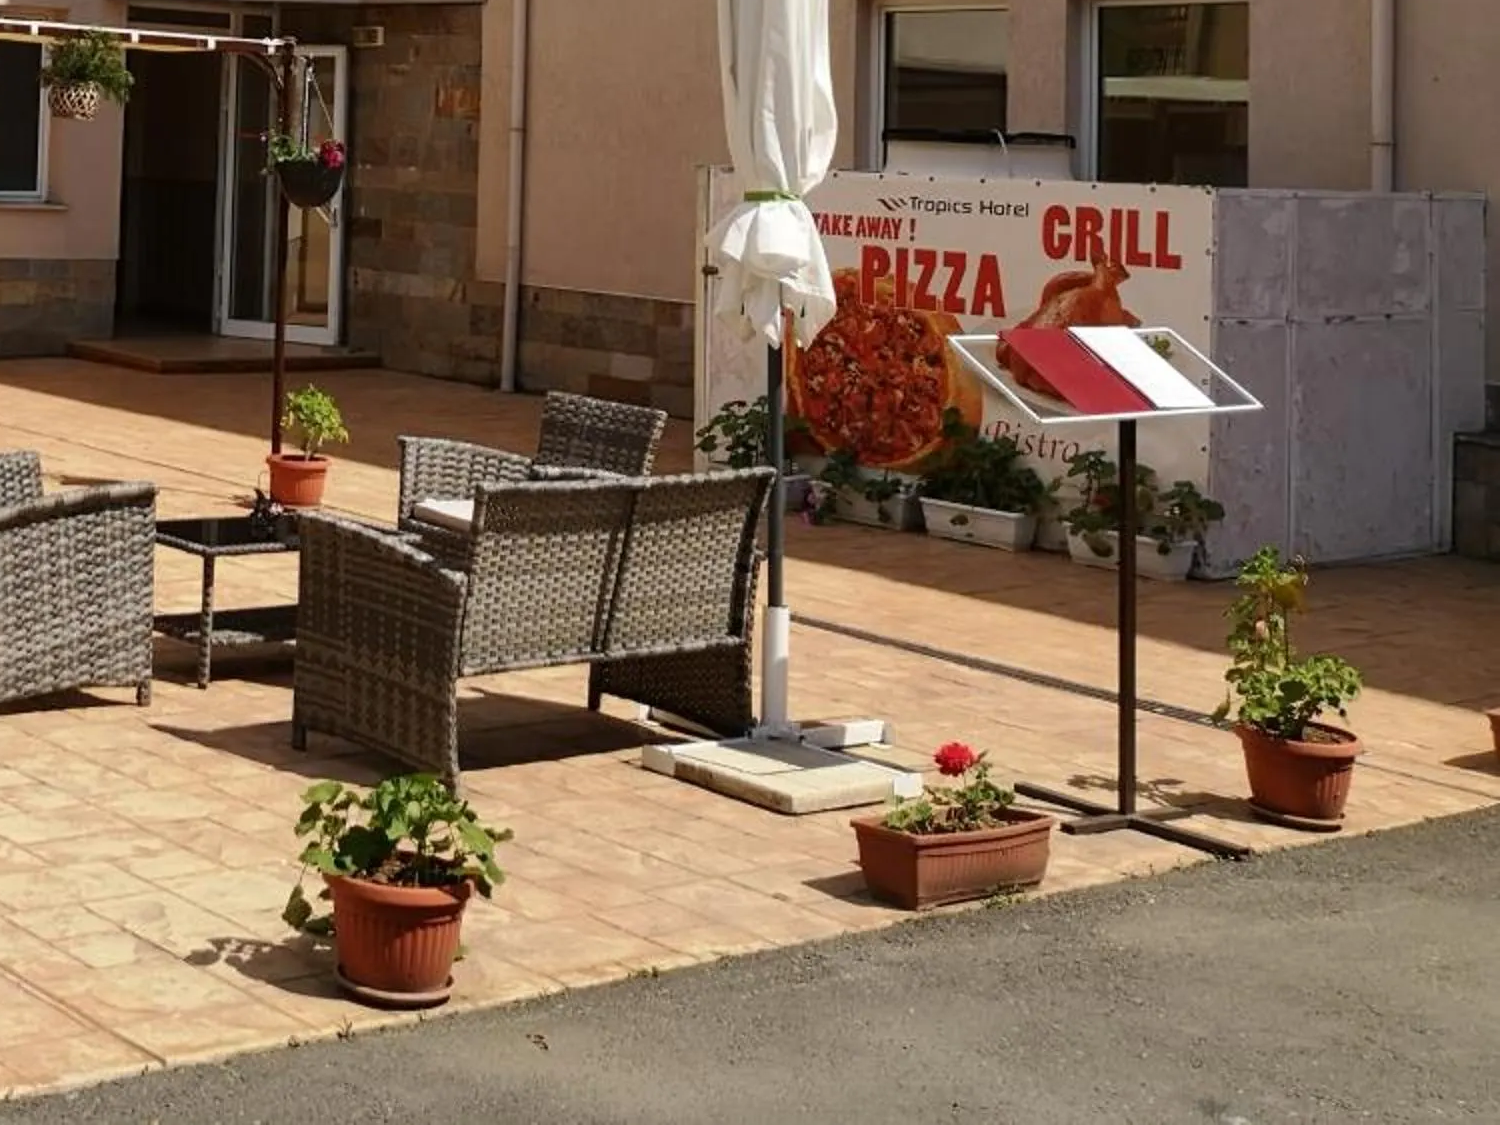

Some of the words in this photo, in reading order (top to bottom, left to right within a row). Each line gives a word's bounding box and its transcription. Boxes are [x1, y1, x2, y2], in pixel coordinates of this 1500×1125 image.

[856, 215, 903, 240] AWAY
[909, 196, 972, 216] Tropics
[979, 200, 1029, 217] Hotel
[1041, 204, 1182, 270] GRILL
[860, 244, 1006, 318] PIZZA
